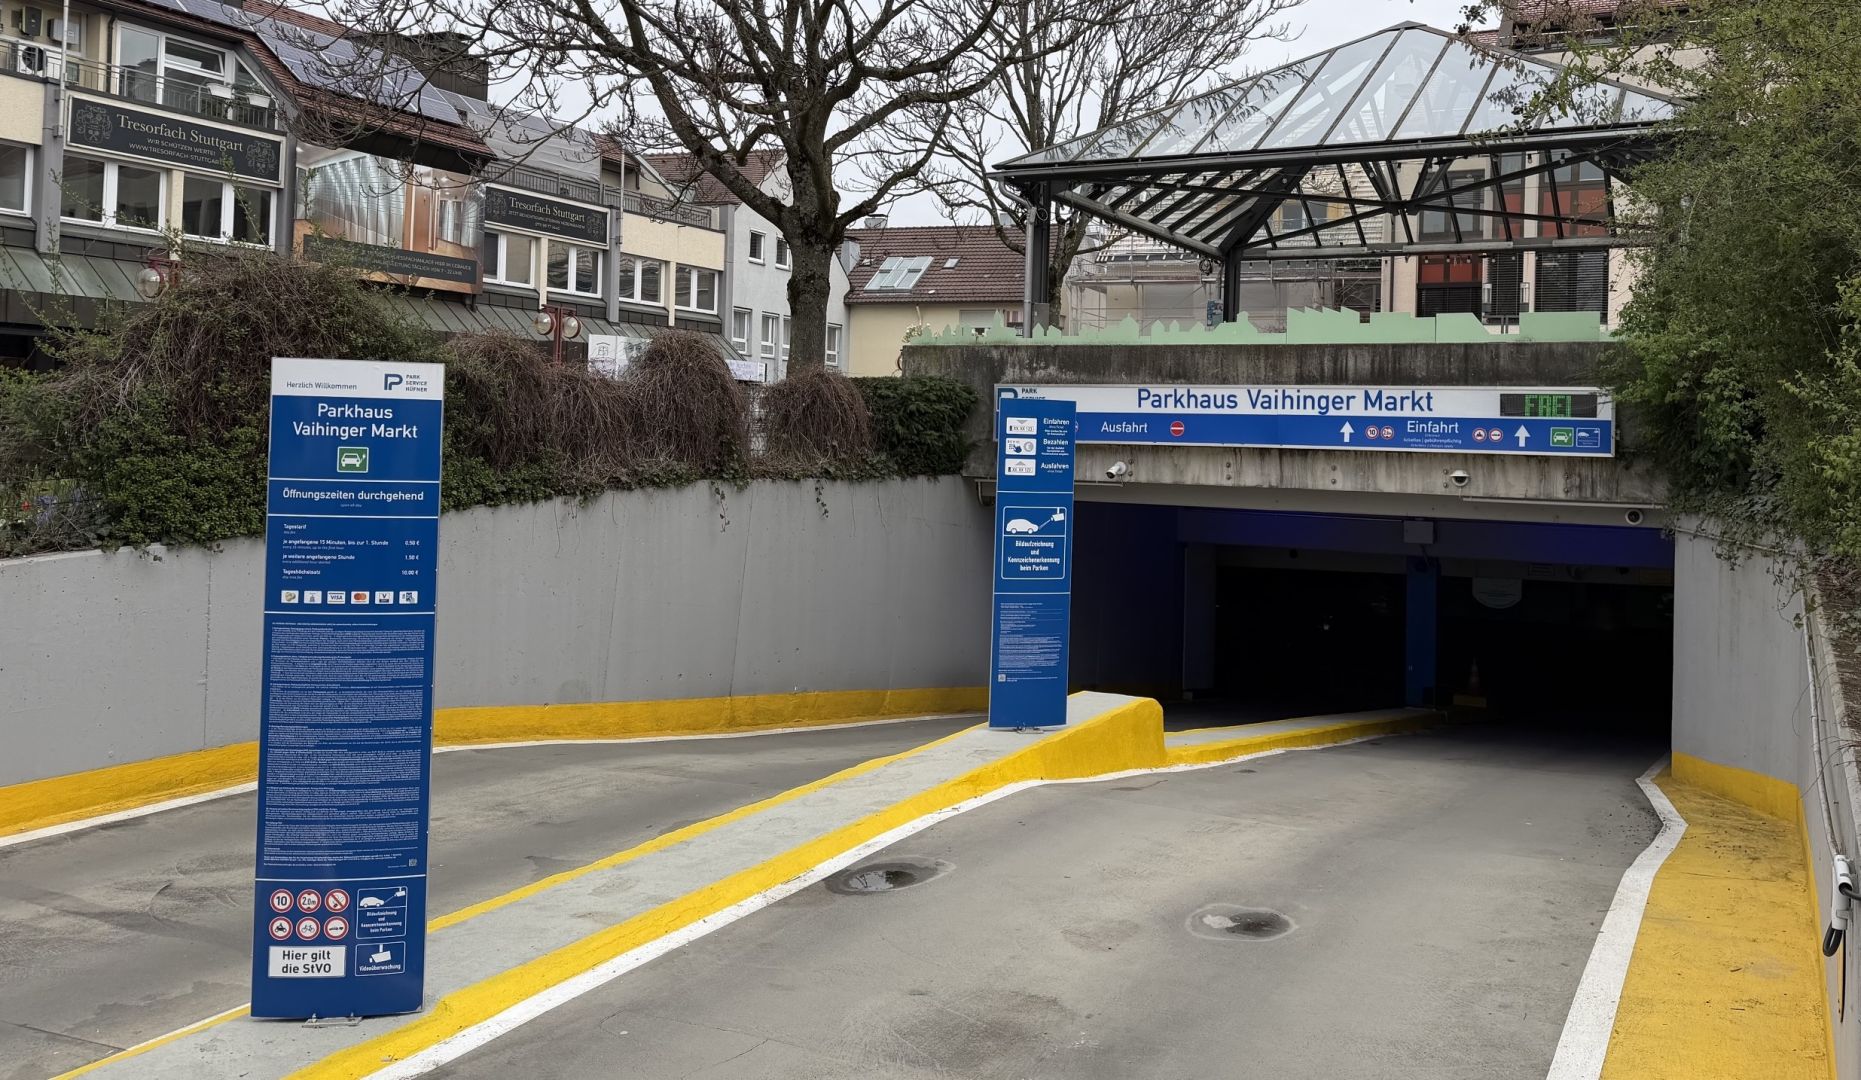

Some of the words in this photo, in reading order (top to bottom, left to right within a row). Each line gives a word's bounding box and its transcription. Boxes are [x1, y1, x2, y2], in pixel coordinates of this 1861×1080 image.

[117, 113, 186, 140] Tresorfach
[190, 130, 244, 152] Stuttgart
[147, 137, 160, 145] WIR
[509, 197, 550, 214] Tresorfach
[552, 207, 585, 222] Stuttgart
[315, 382, 357, 390] Willkommen
[1137, 388, 1238, 410] Parkhaus
[1247, 389, 1356, 415] Vaihinger
[1364, 390, 1434, 412] Markt
[1524, 394, 1572, 418] FREI
[318, 403, 393, 419] Parkhaus
[293, 421, 367, 440] Vaihinger
[372, 424, 417, 438] Markt
[1101, 421, 1148, 433] Ausfahrt
[1407, 420, 1459, 434] Einfahrt
[1043, 438, 1069, 446] Bezahlen
[1040, 462, 1069, 470] Ausfahren
[283, 487, 355, 501] Öffnungszeiten
[358, 491, 424, 502] durchgehend
[1016, 540, 1055, 549] Bildaufzeichnung
[1008, 556, 1061, 565] Kennzeichenerkennung
[276, 896, 287, 906] 10
[282, 950, 307, 961] Hier
[311, 950, 331, 963] gilt
[282, 964, 301, 973] die
[303, 963, 332, 974] StVO
